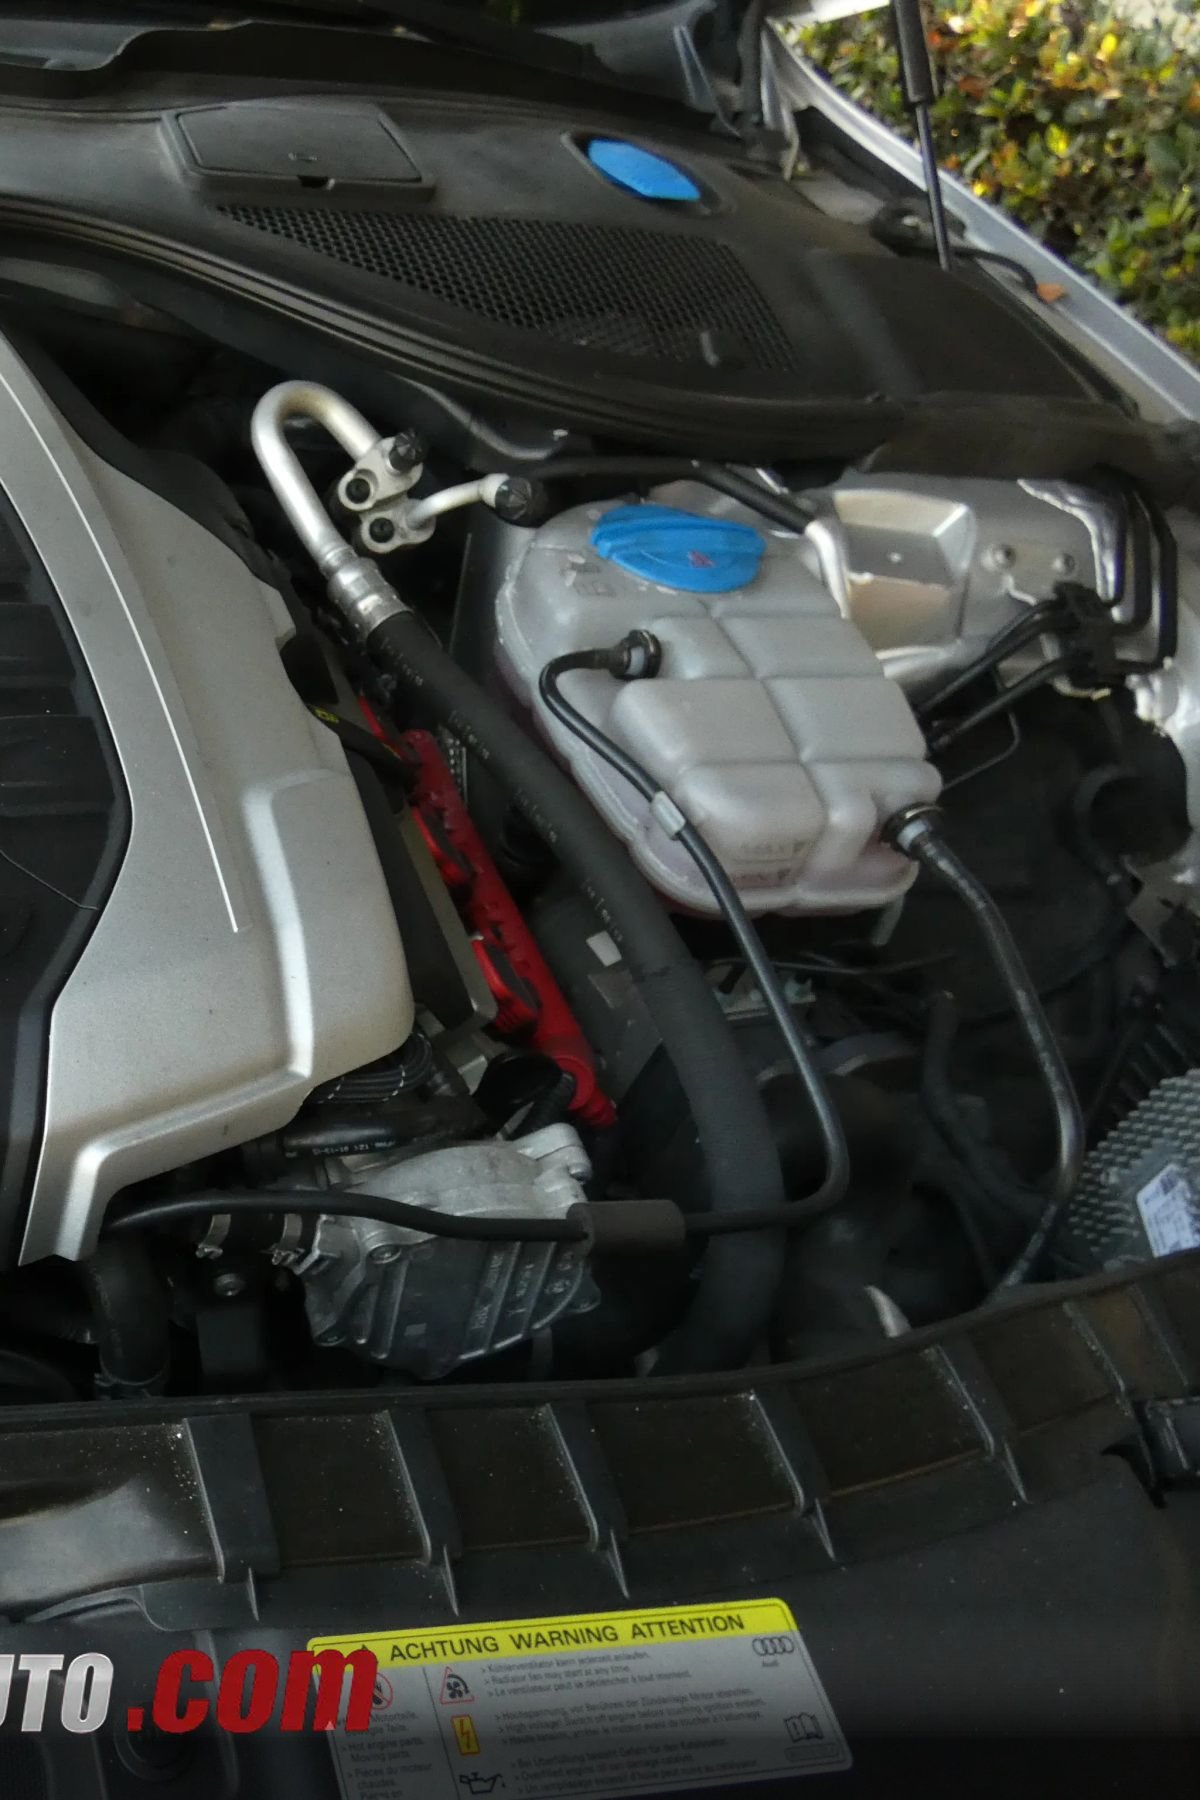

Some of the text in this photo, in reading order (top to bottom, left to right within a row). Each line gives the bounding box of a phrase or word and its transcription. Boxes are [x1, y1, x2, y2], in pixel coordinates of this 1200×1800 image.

[390, 1614, 745, 1661] ACHTUNG WARNING ATTENTION
